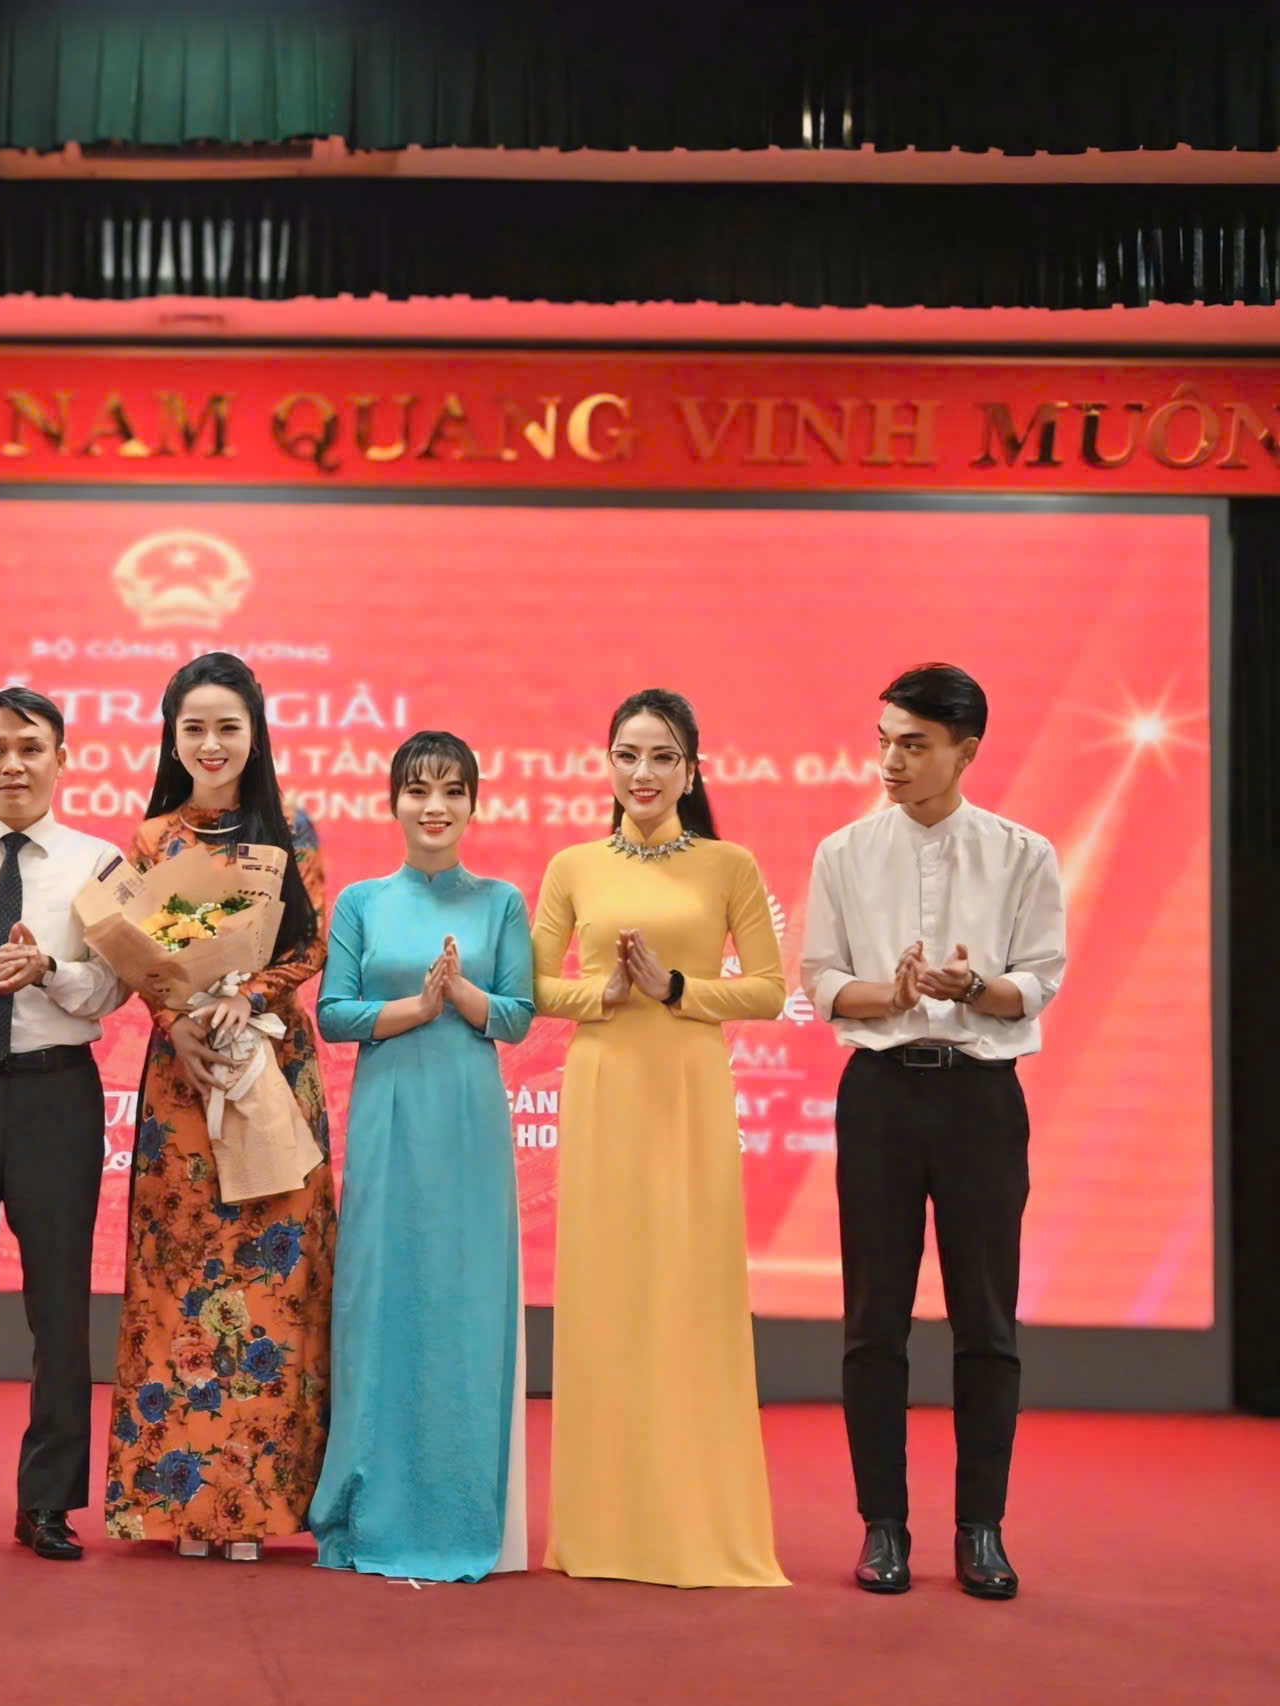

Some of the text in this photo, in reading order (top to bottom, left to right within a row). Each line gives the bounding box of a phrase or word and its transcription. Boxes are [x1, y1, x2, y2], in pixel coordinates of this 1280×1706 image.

[0, 390, 238, 458] NAM
[271, 390, 632, 474] QUANG
[672, 395, 942, 467] VINH
